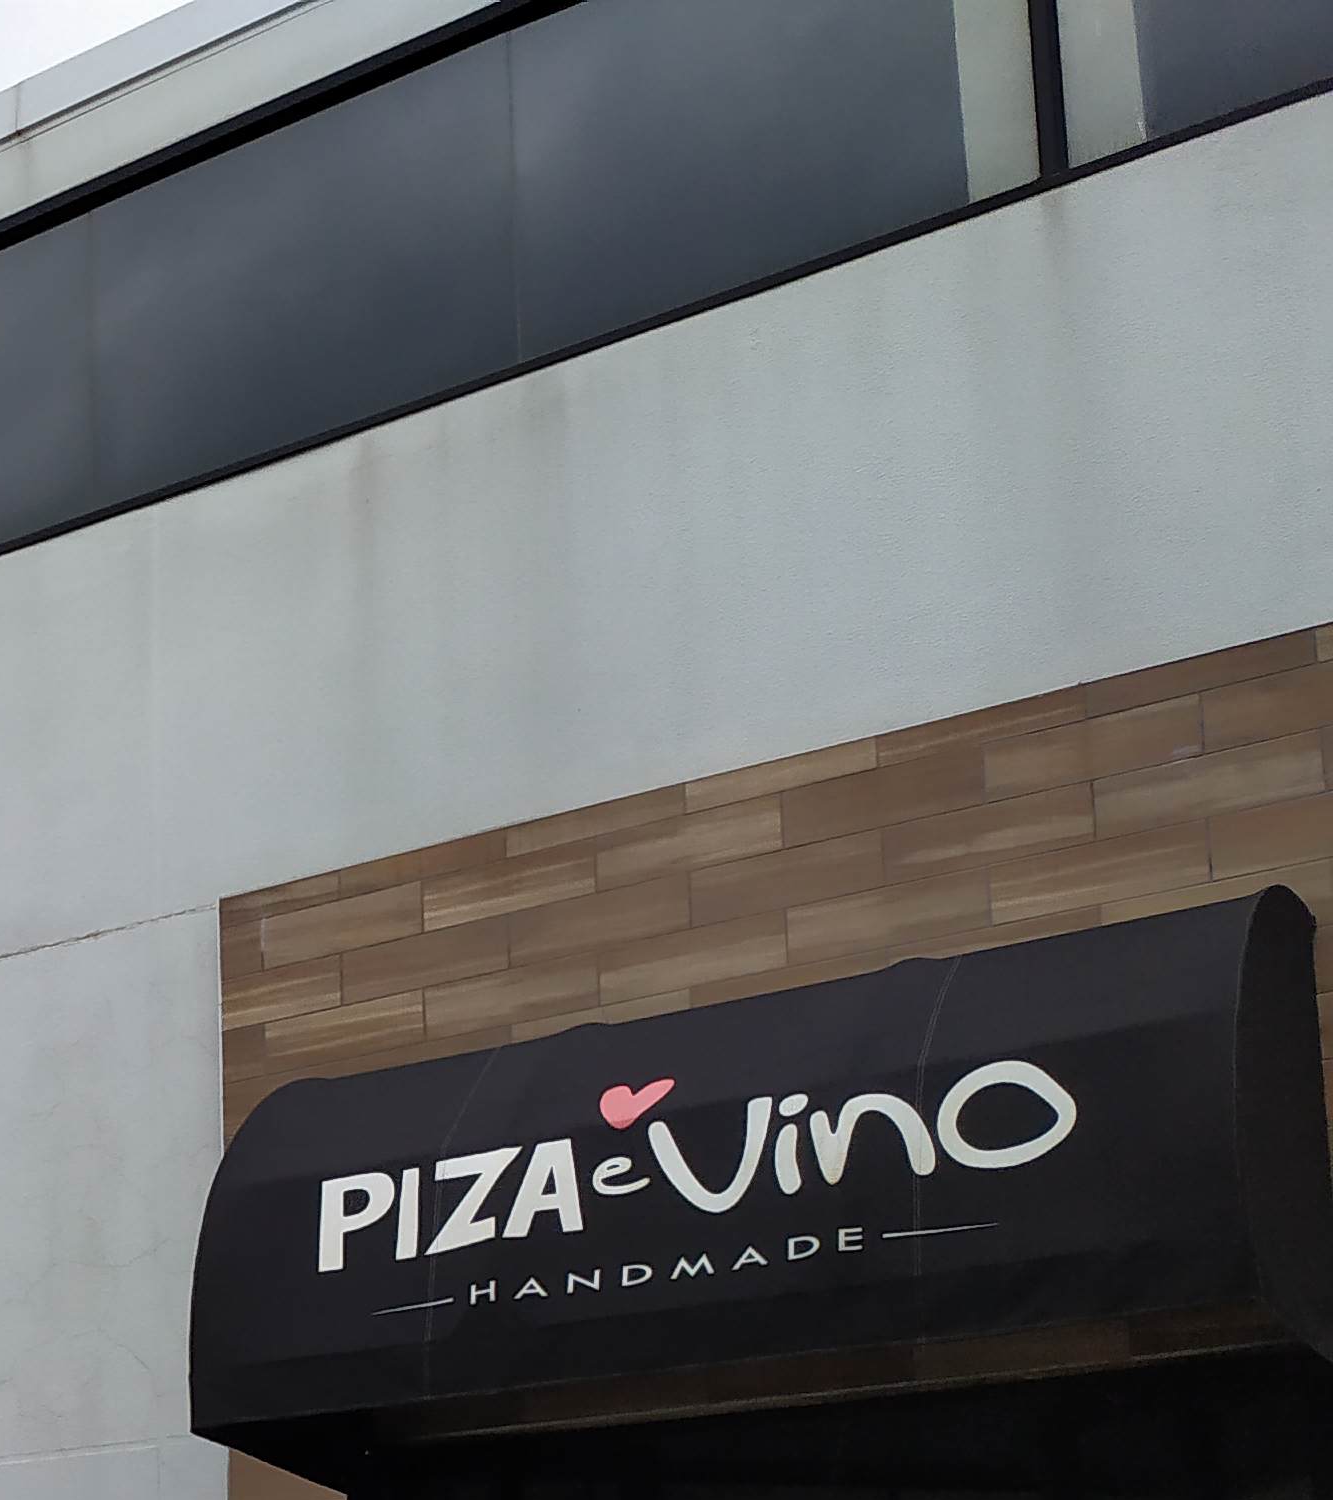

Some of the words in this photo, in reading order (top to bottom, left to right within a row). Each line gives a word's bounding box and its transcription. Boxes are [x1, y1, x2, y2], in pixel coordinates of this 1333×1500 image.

[318, 1138, 583, 1272] PIZA
[648, 1060, 1077, 1213] Vino
[470, 1227, 863, 1305] HANDMADE
